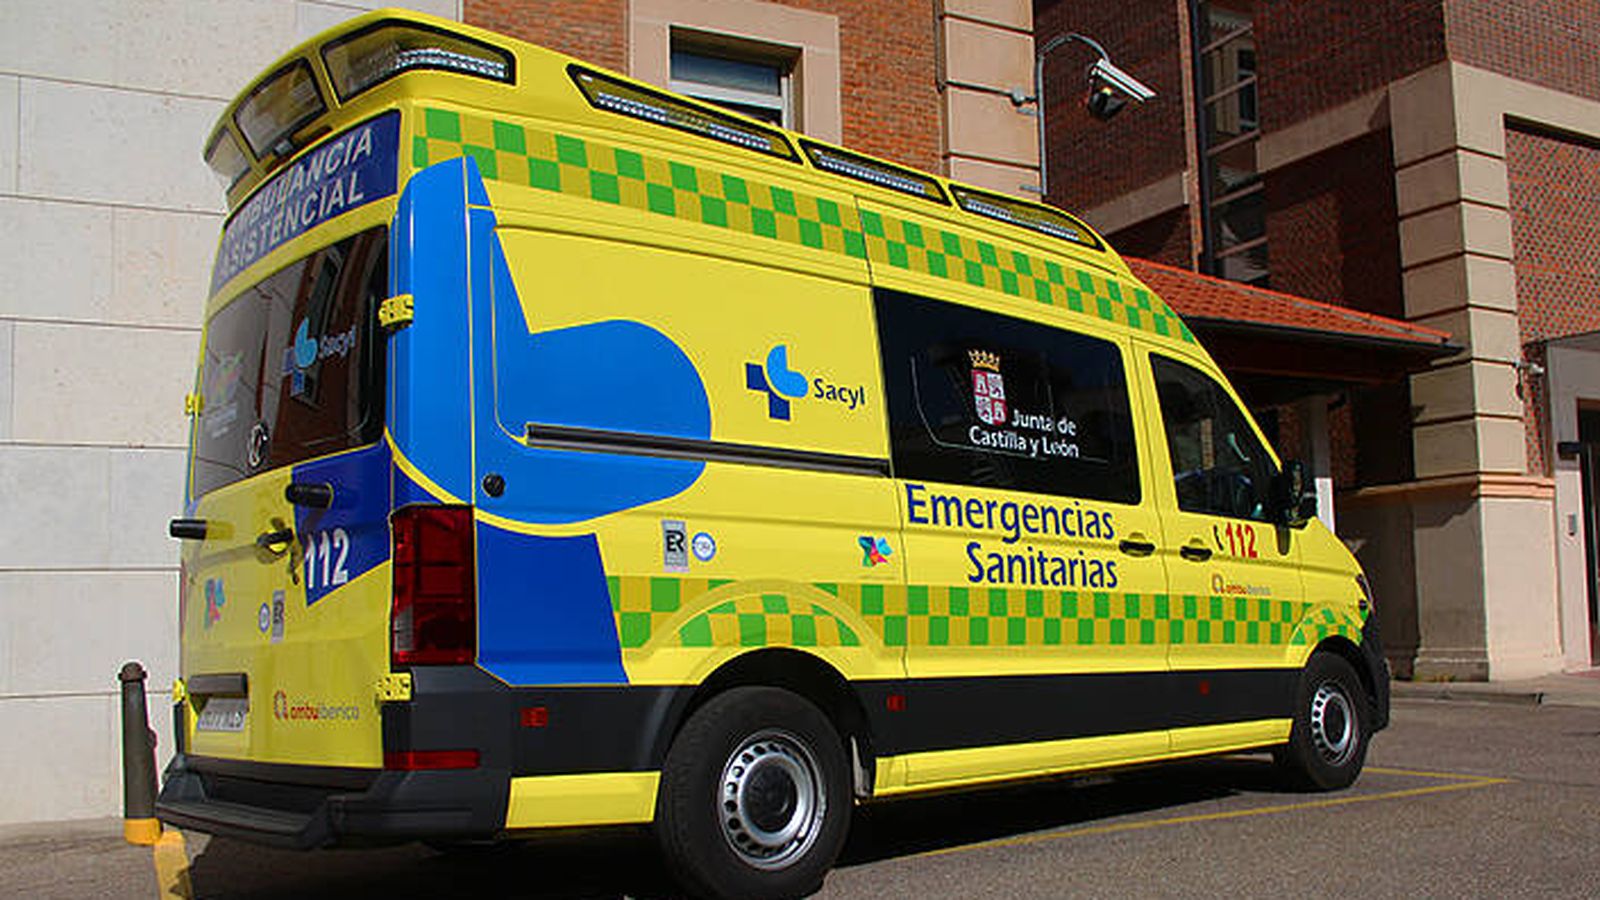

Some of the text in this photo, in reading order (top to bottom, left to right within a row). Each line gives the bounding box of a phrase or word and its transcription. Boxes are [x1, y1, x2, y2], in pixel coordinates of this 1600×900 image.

[224, 128, 372, 246] BULANCIA
[814, 378, 865, 410] Sacyl
[969, 426, 1079, 459] Castilla y León
[1011, 408, 1076, 436] Junta de
[904, 482, 1115, 544] Emergencias
[305, 528, 349, 588] 112
[1225, 521, 1258, 559] 112
[966, 541, 1118, 588] Sanitarias
